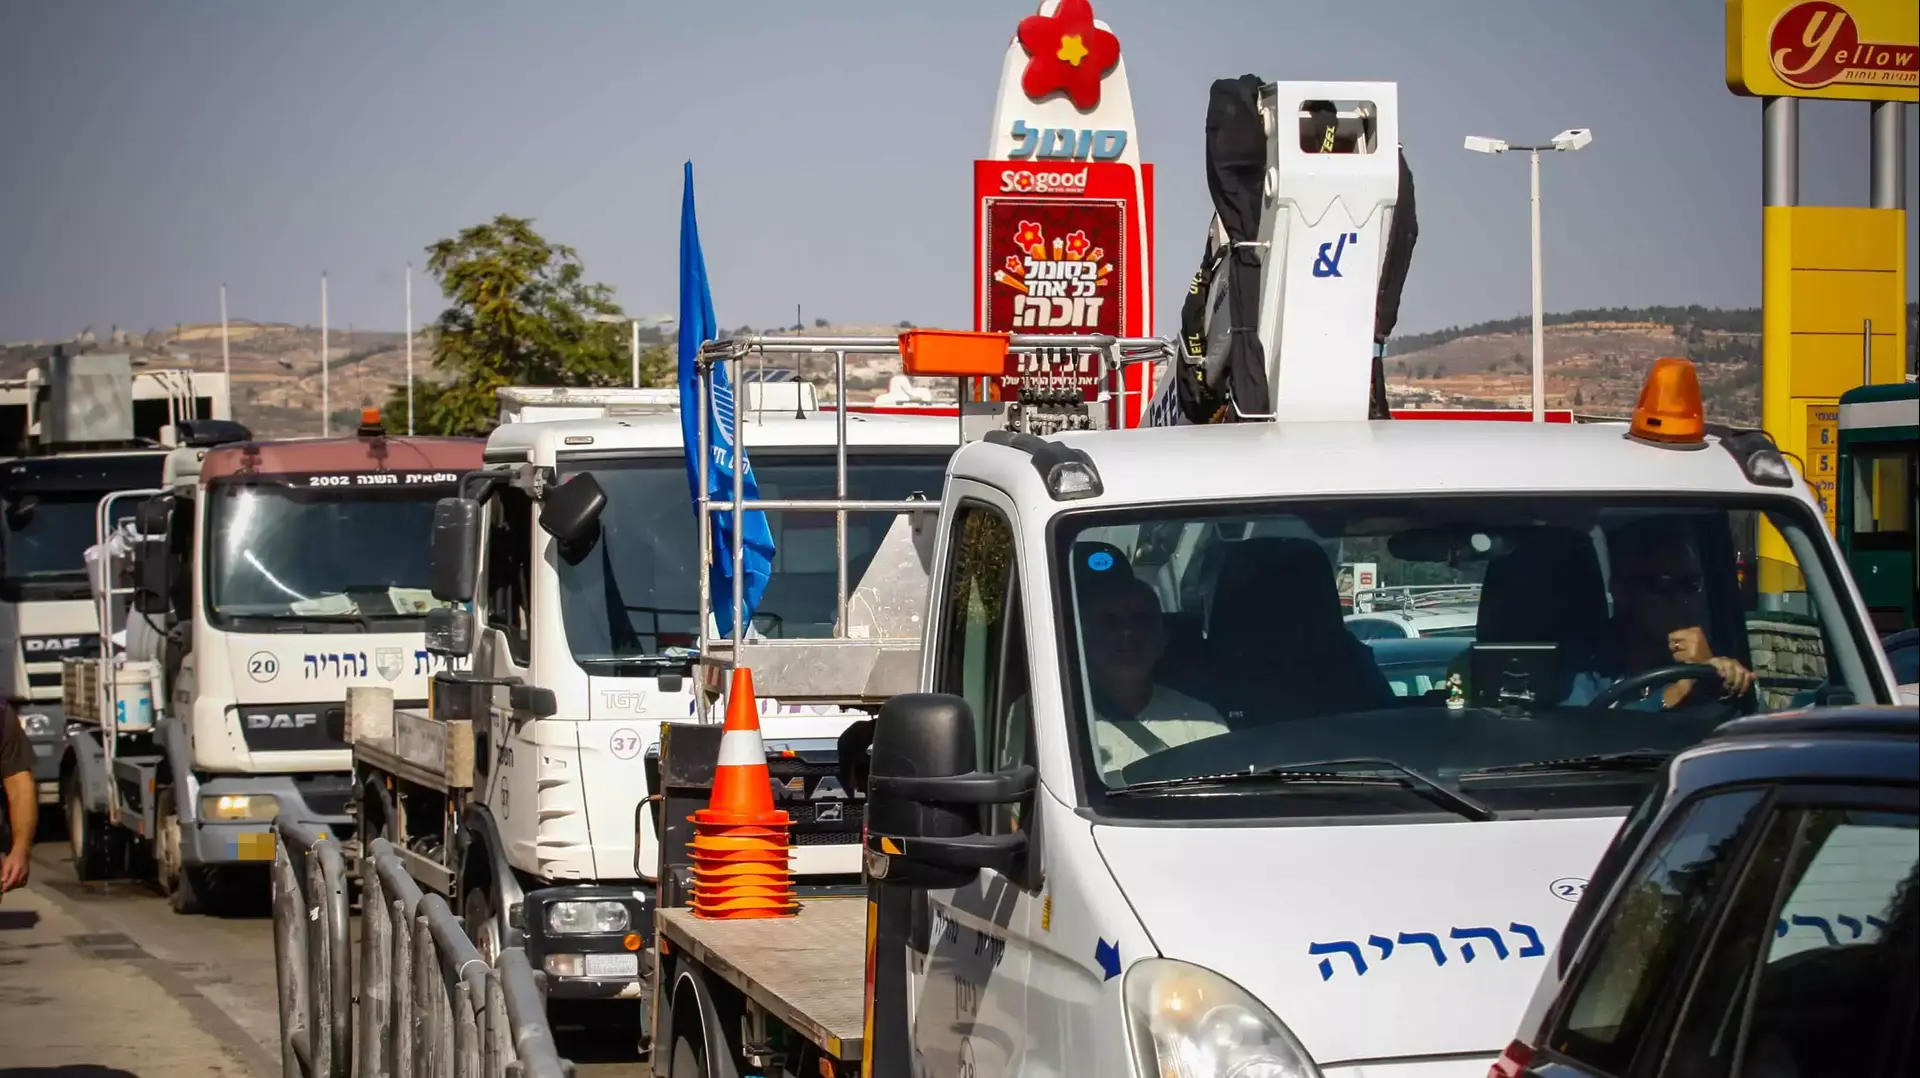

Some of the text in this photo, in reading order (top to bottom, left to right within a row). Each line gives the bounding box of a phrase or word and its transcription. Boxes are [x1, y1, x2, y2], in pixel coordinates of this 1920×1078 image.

[1008, 119, 1127, 159] סונול
[1023, 256, 1098, 280] בסונול
[1024, 276, 1096, 296] כל אחד
[1012, 294, 1104, 327] זוכה!
[309, 475, 351, 486] 2002
[356, 474, 398, 485] השנה
[26, 638, 80, 652] DAF
[251, 660, 276, 674] 20
[303, 651, 368, 680] נהריה
[247, 714, 317, 728] DAF
[613, 737, 638, 751] 37
[1308, 921, 1547, 982] נהריה
